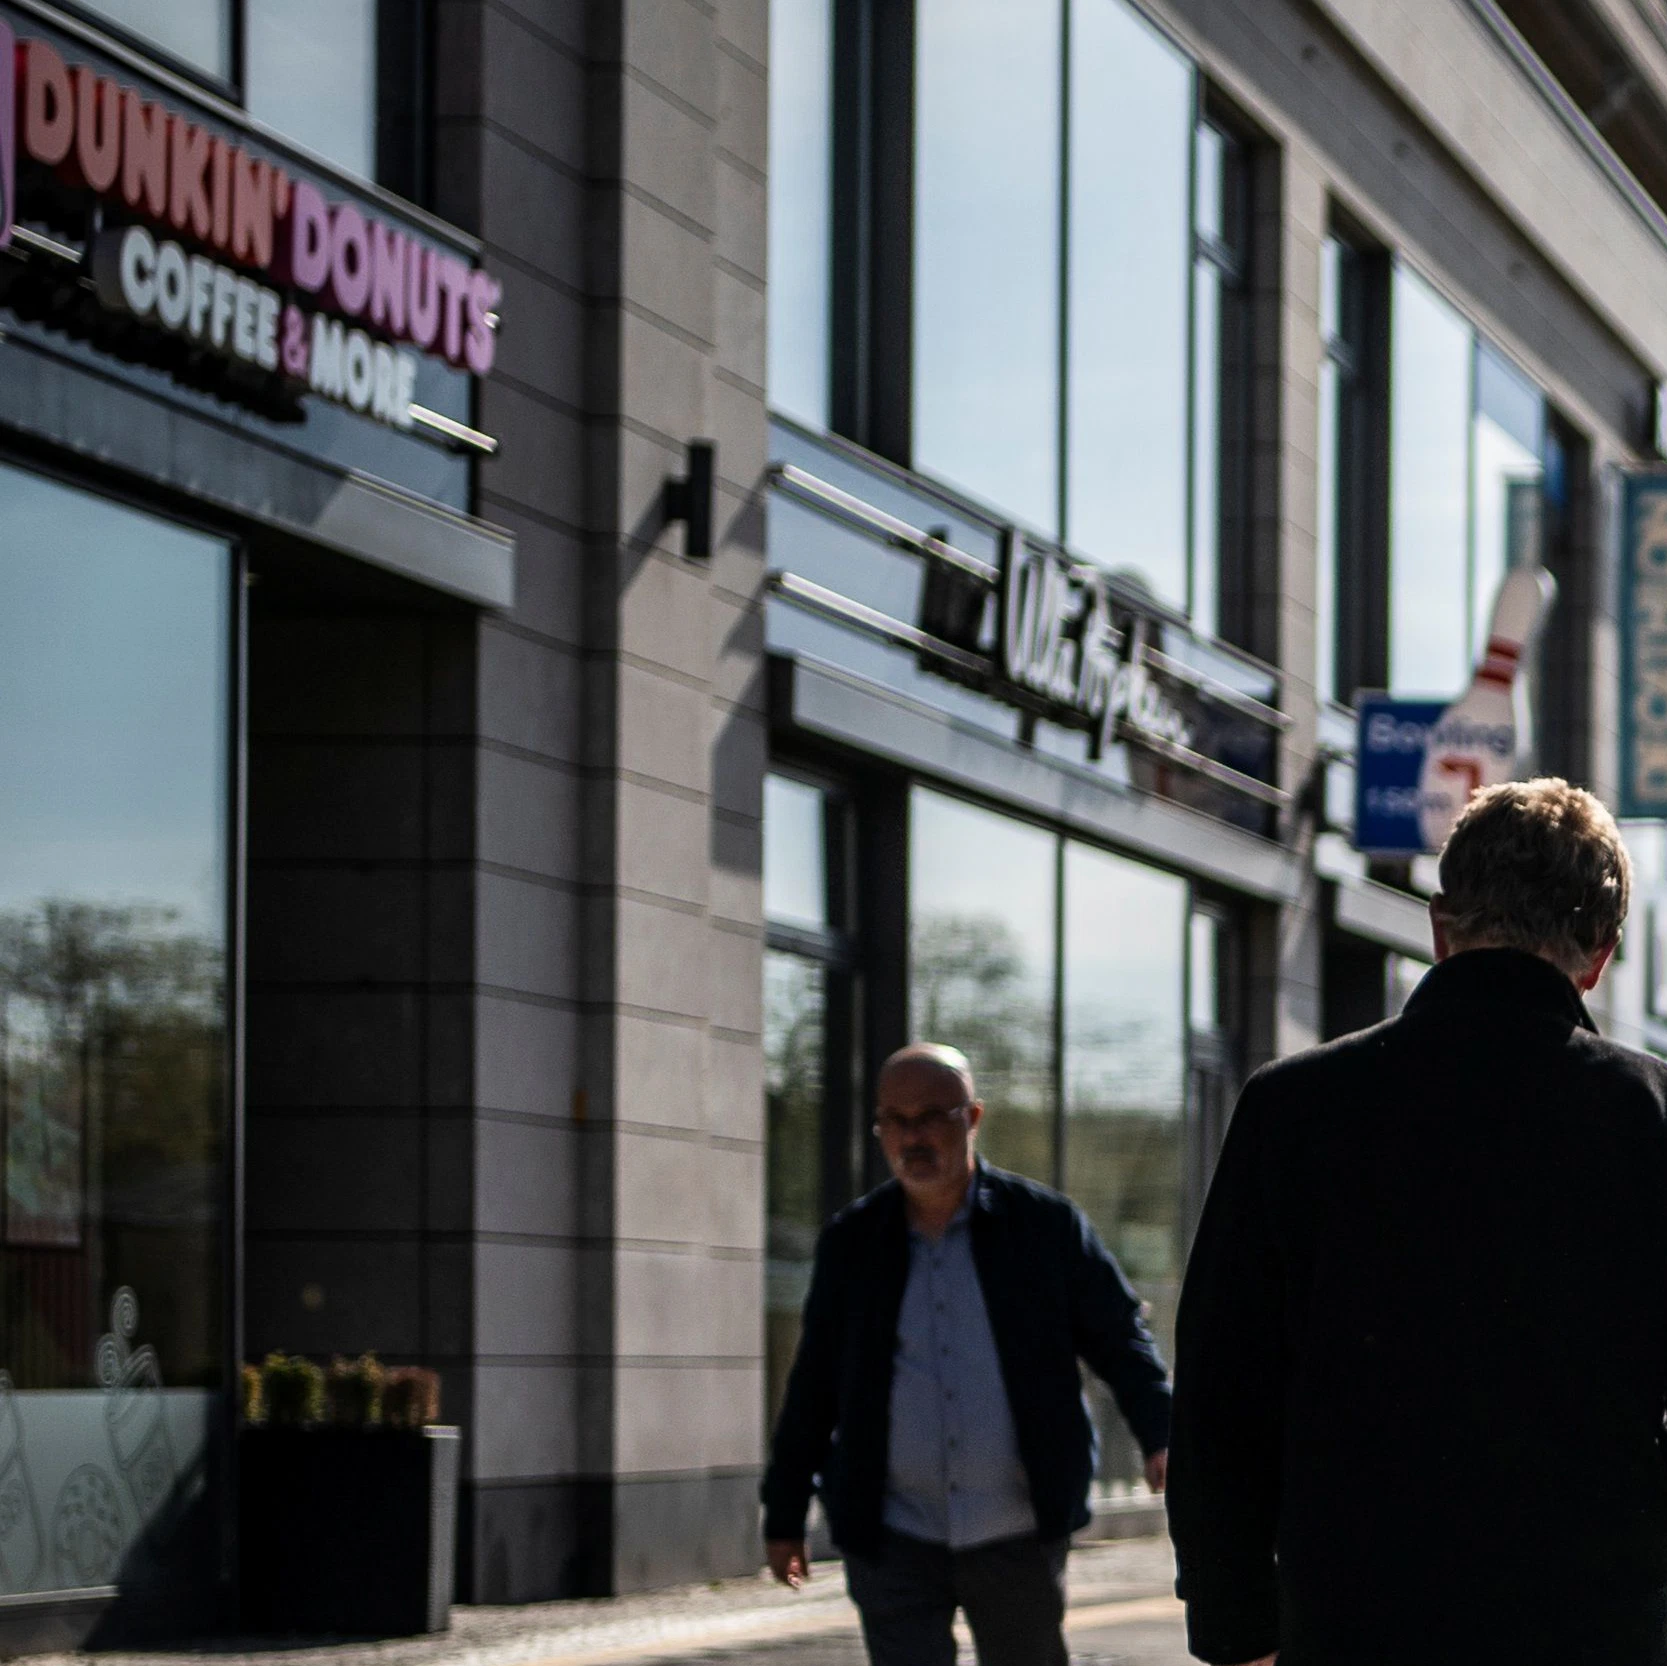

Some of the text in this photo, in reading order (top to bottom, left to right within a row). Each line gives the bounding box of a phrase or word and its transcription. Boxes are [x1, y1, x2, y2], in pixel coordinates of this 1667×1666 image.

[22, 38, 500, 375] DUNKIN' DONUTS
[119, 226, 418, 428] COFFEE & MORE
